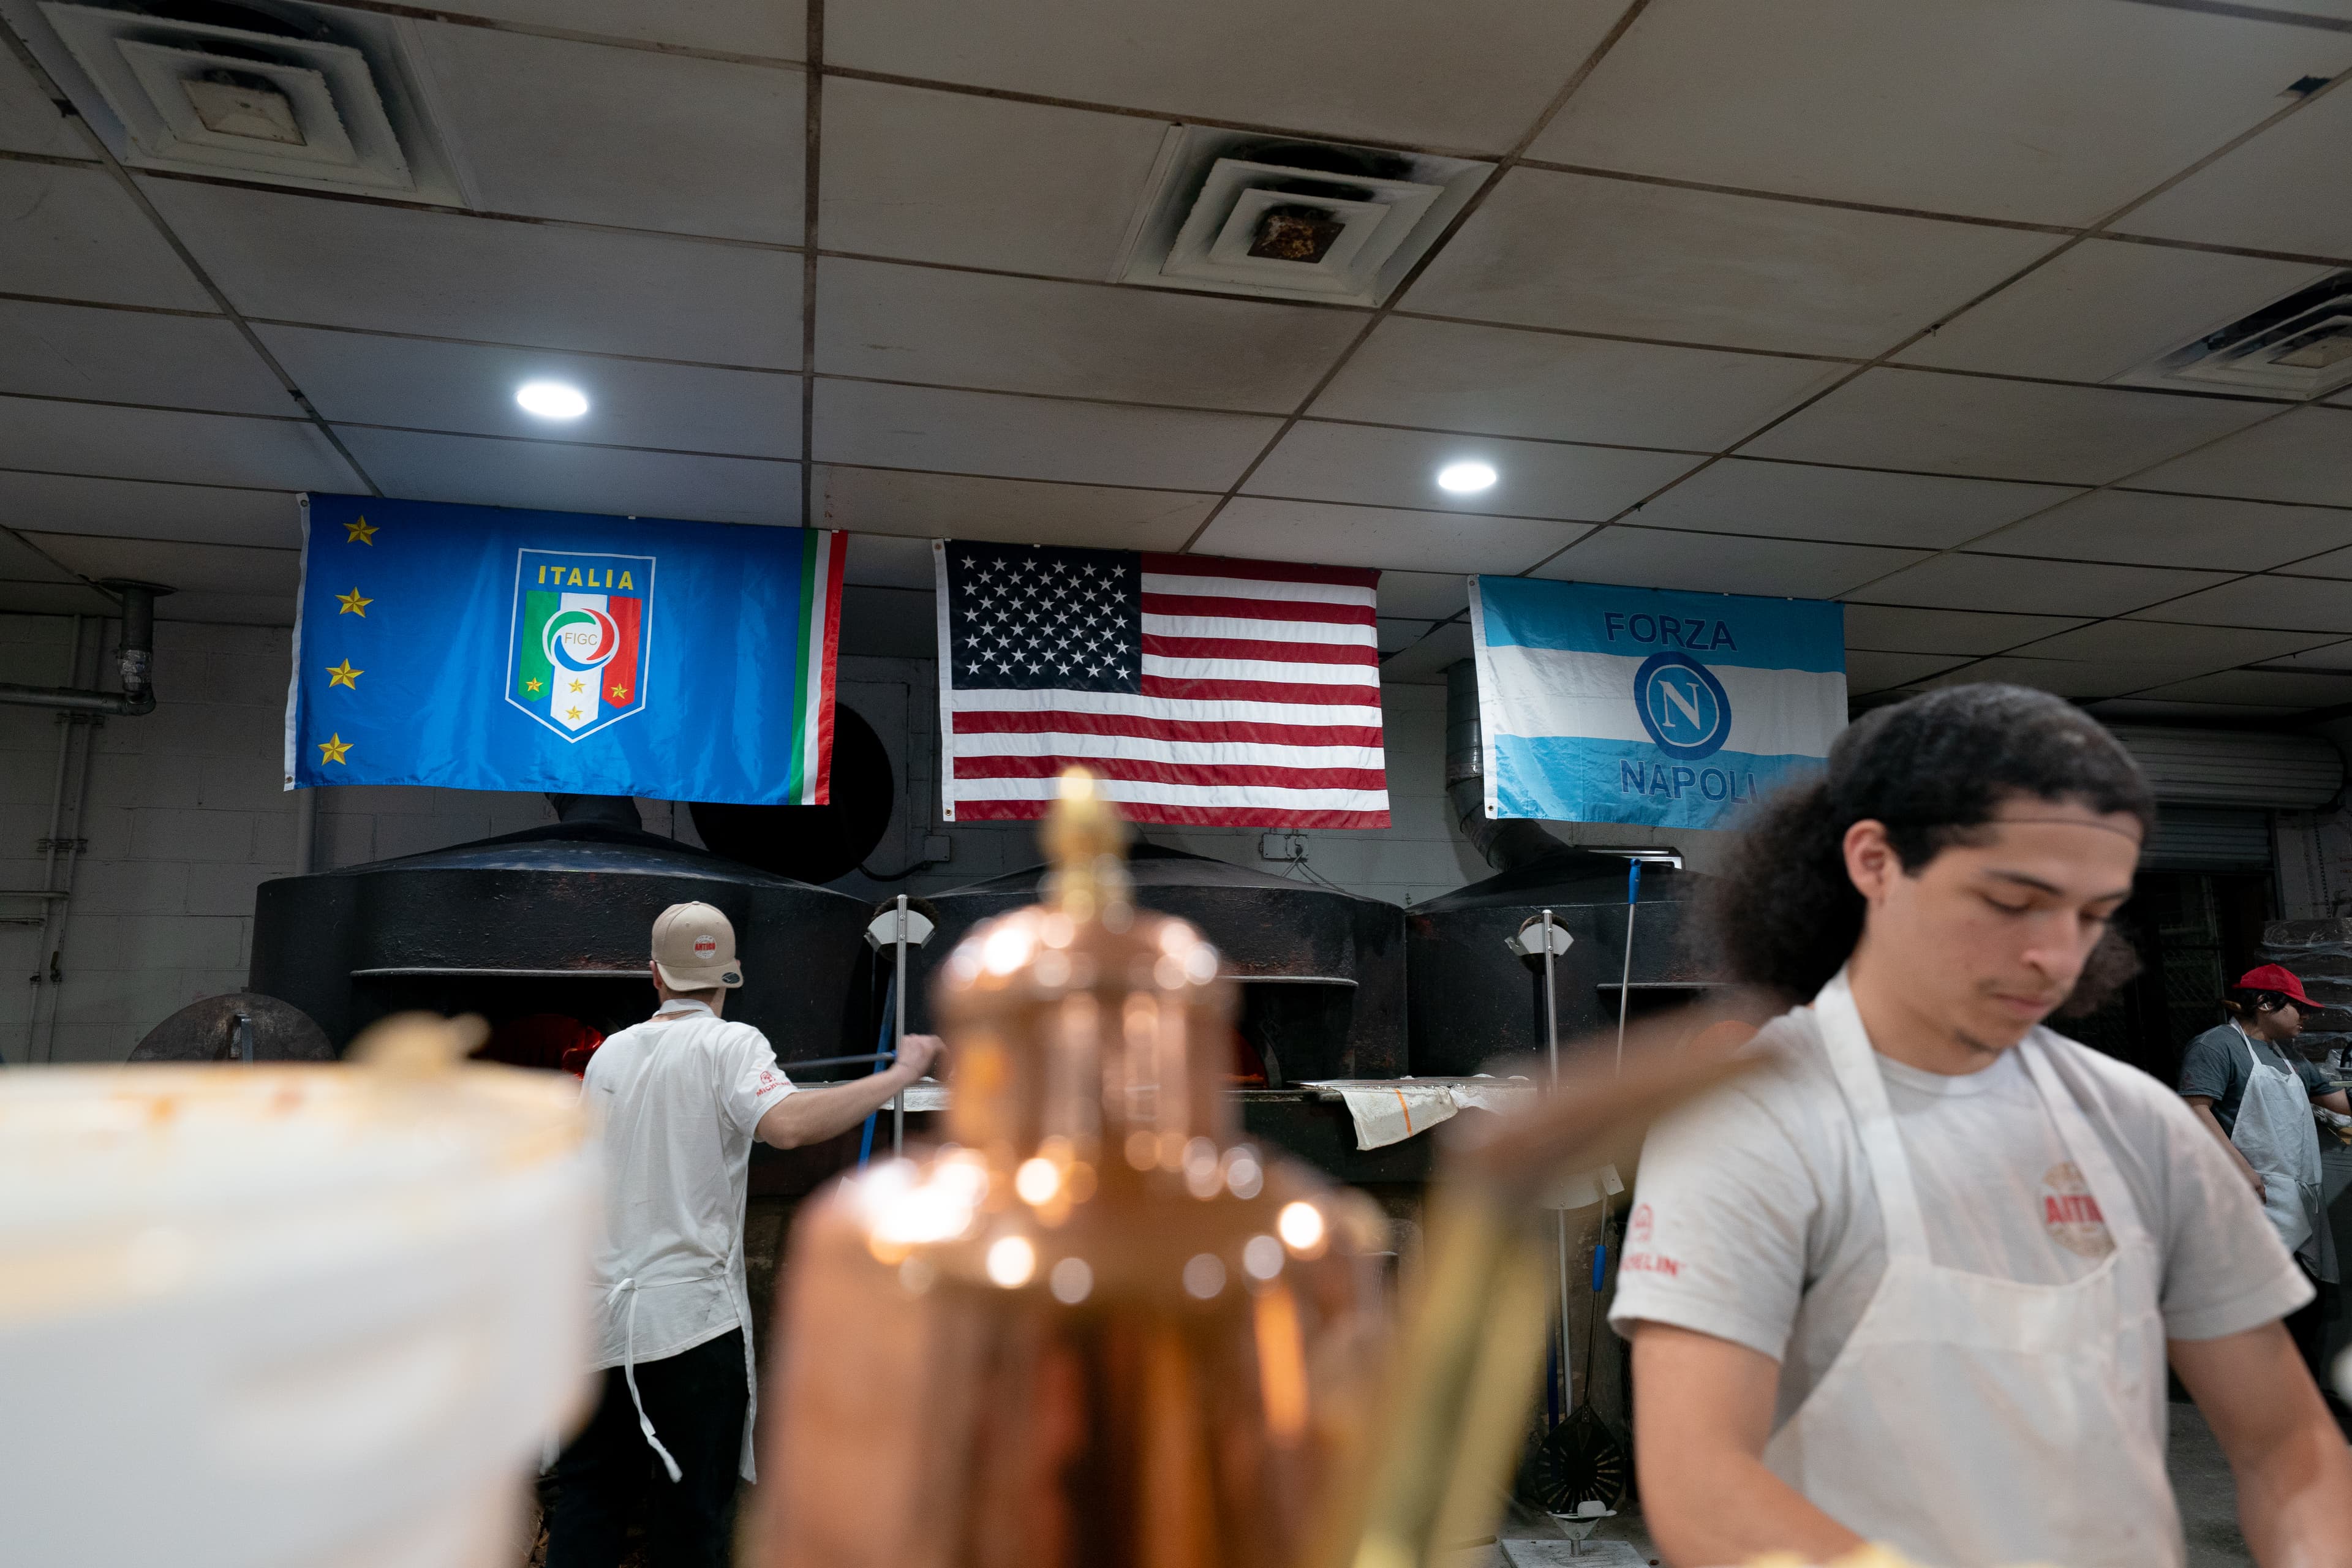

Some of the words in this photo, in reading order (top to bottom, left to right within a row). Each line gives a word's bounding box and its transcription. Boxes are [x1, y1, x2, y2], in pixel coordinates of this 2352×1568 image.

[537, 565, 634, 591] ITALIA
[564, 632, 598, 646] FIGC
[1603, 611, 1738, 652] FORZA
[1657, 680, 1701, 731] N
[1619, 759, 1760, 805] NAPOLI
